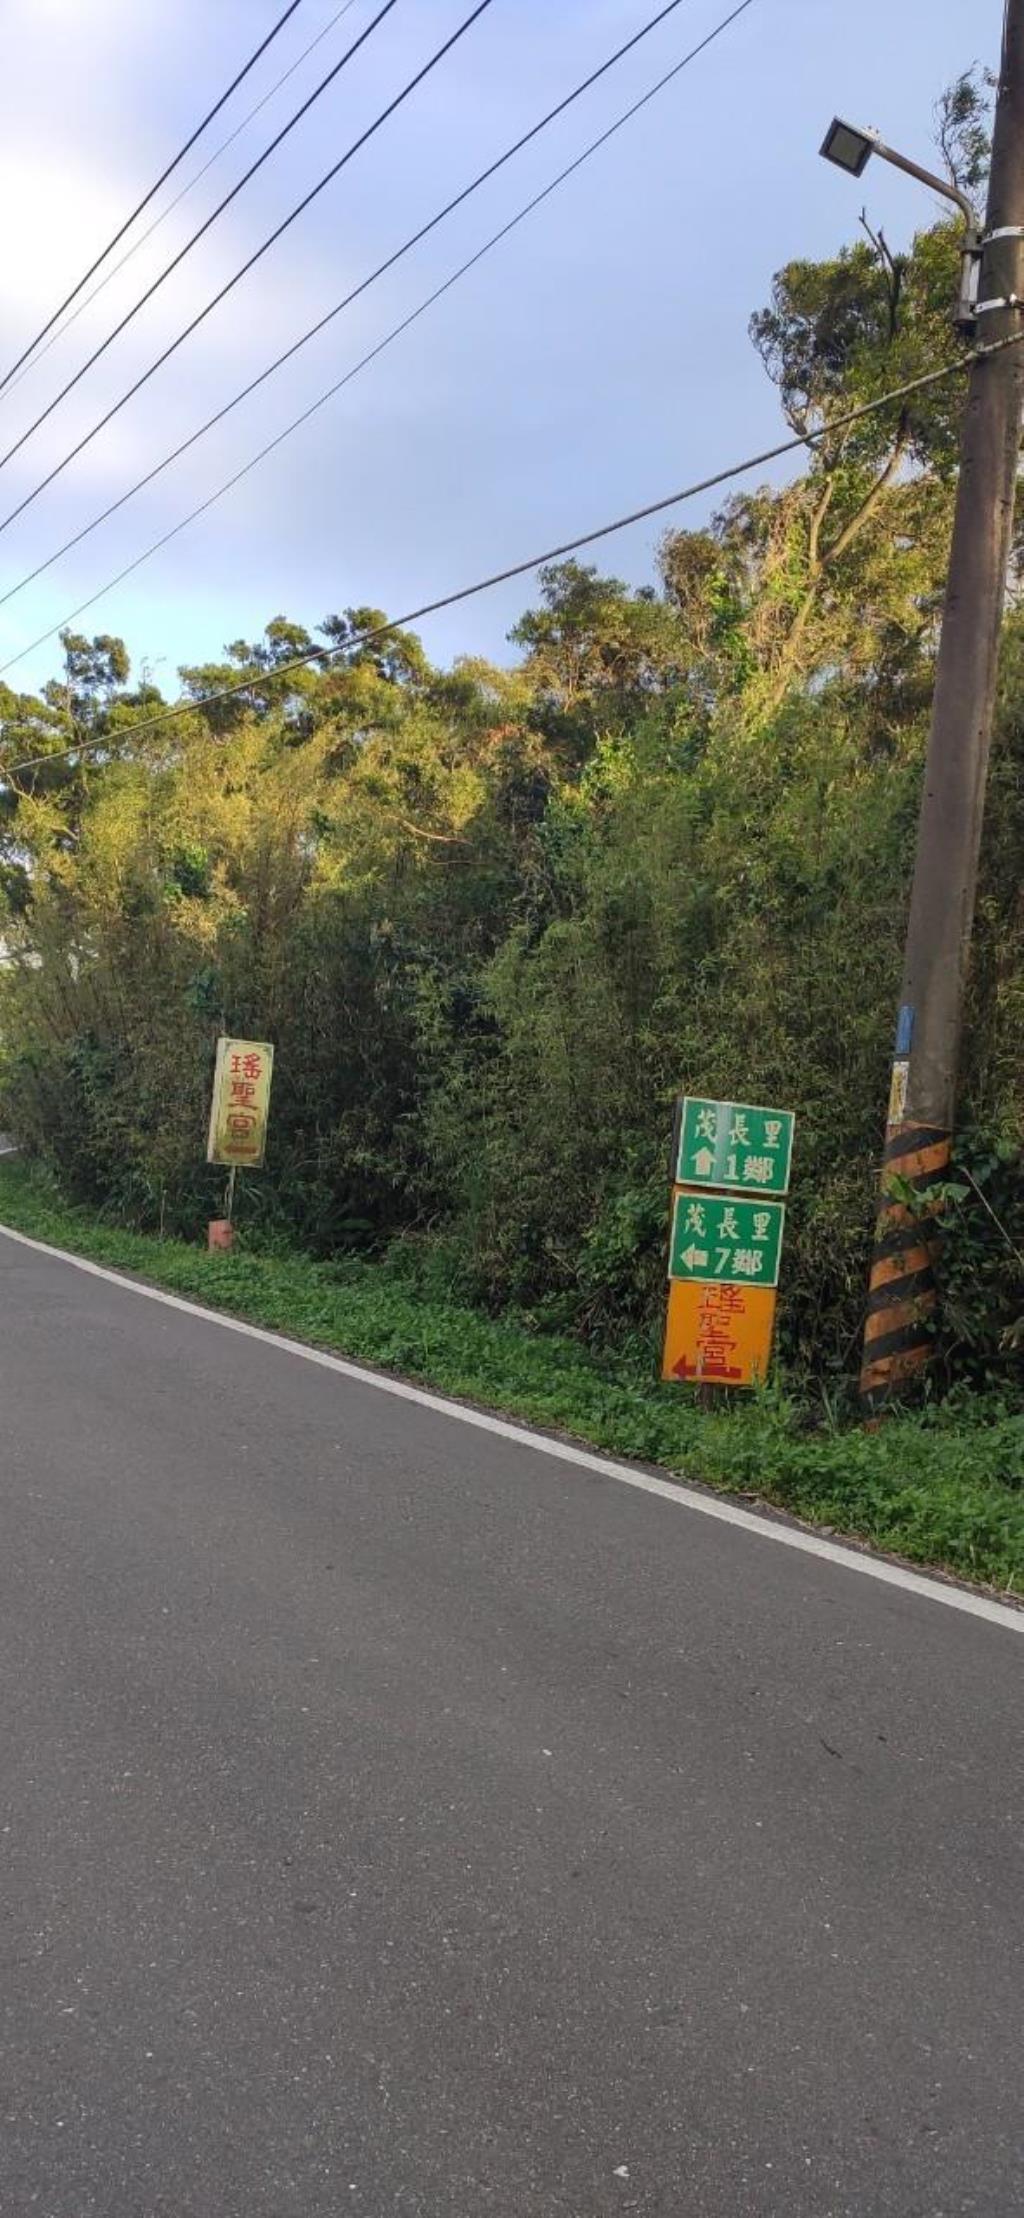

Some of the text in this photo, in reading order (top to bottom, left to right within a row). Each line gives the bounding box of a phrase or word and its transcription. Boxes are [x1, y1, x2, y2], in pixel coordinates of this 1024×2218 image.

[693, 1108, 783, 1149] 茂長里
[723, 1153, 775, 1184] 1鄰
[684, 1202, 772, 1242] 茂長里
[712, 1246, 764, 1277] 7鄰
